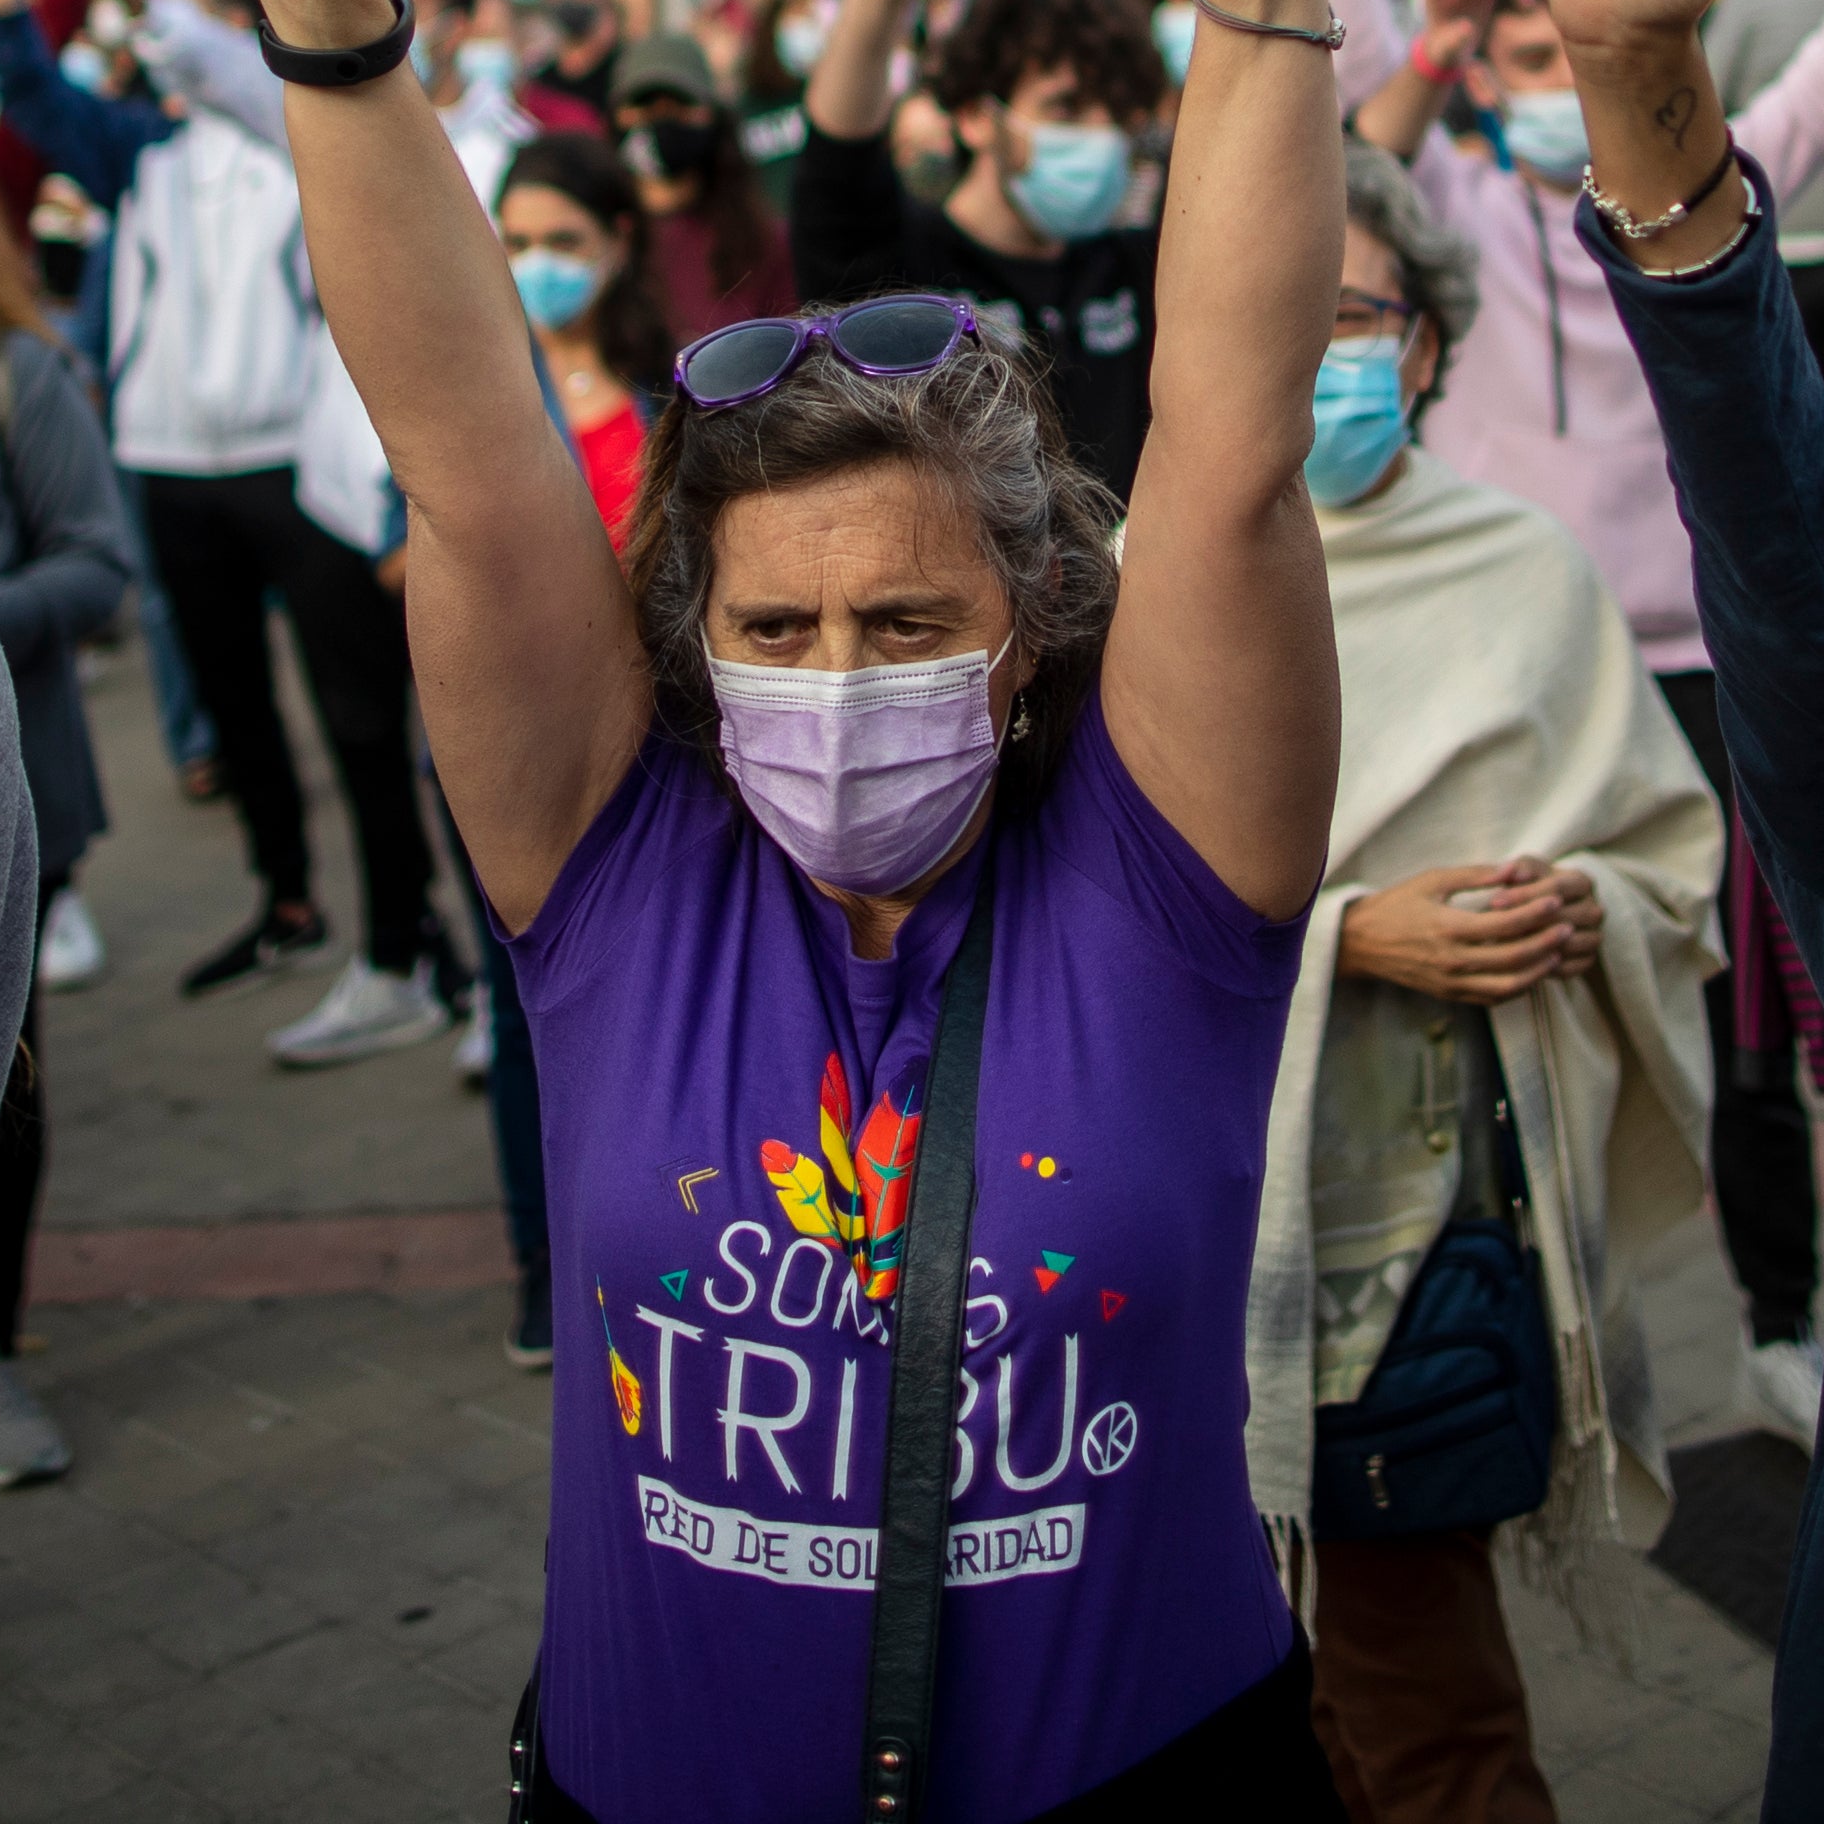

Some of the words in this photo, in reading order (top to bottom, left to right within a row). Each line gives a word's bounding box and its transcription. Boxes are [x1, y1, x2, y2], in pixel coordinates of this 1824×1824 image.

[704, 1220, 1007, 1347] SOMS
[644, 1488, 716, 1556] RED
[731, 1521, 788, 1575] DE
